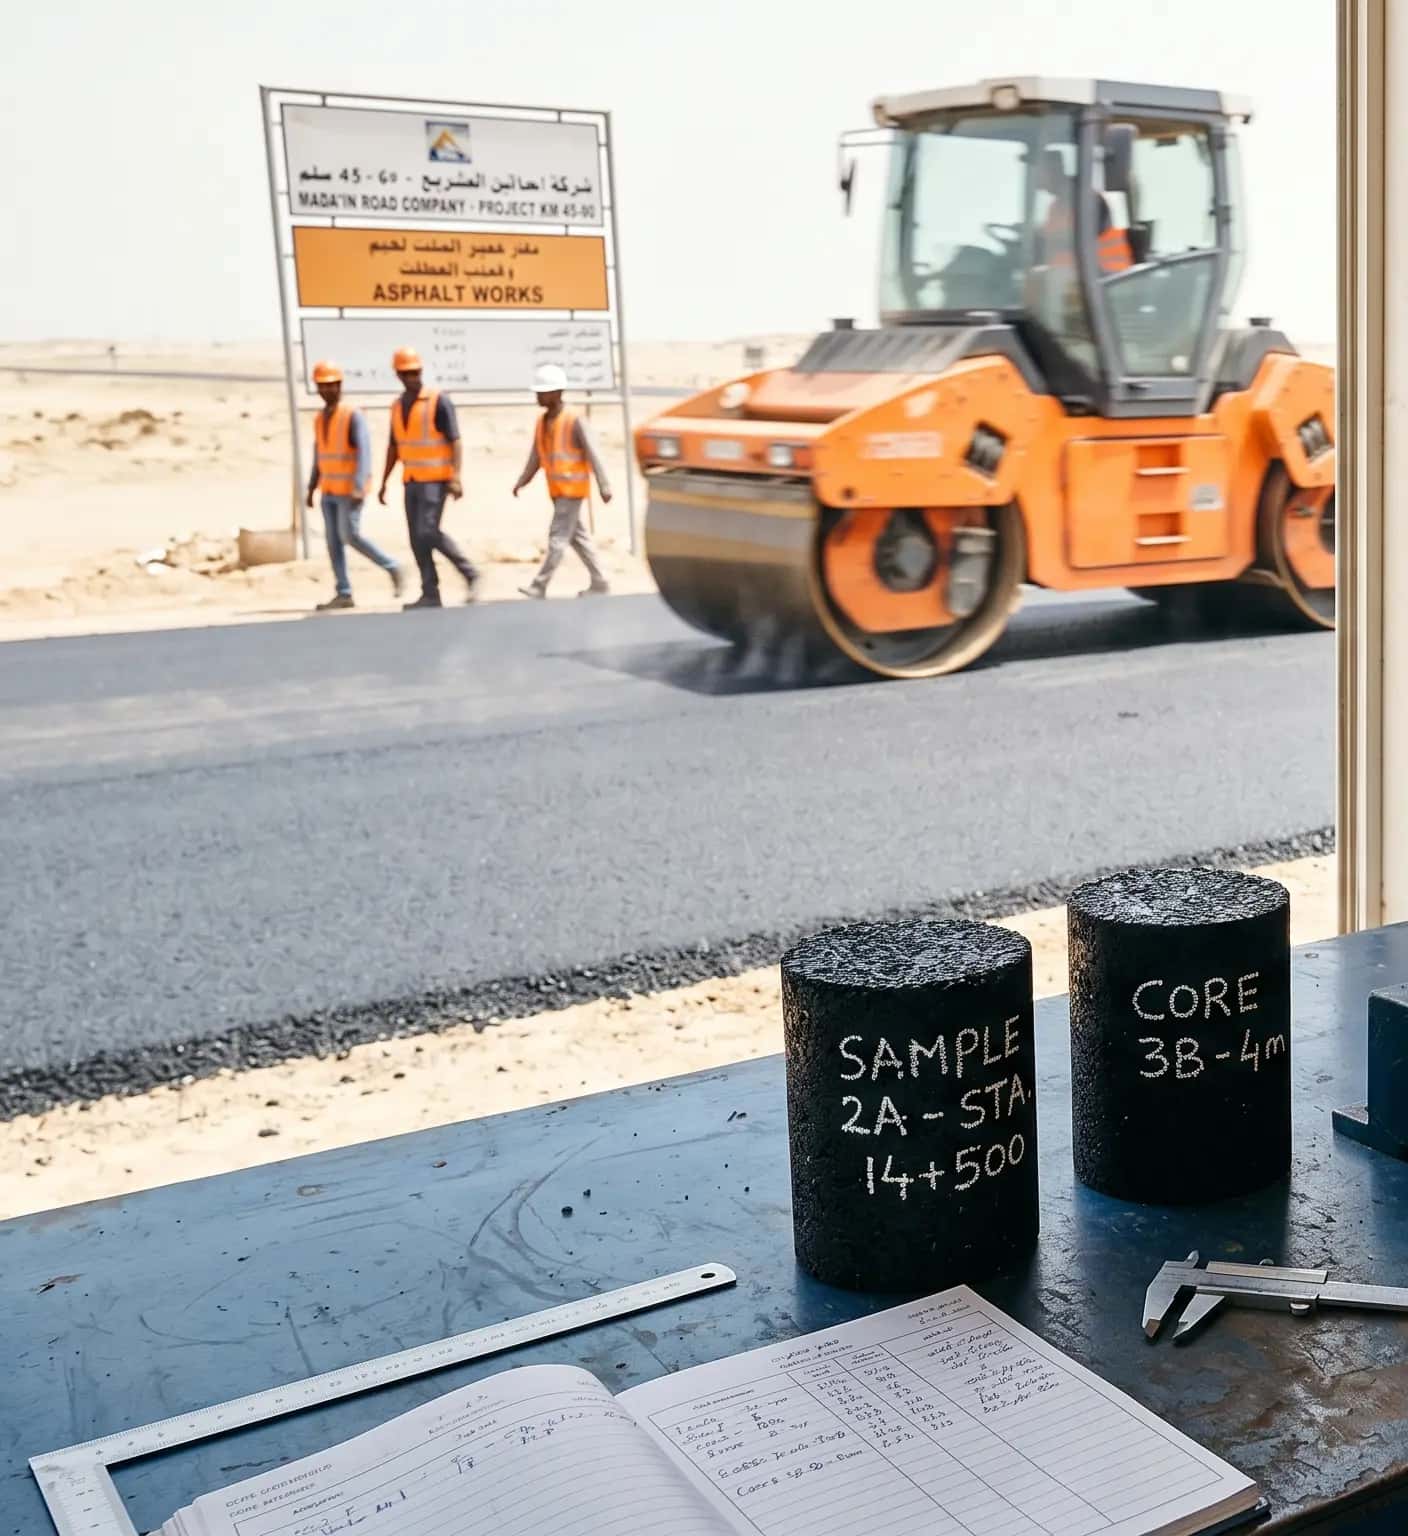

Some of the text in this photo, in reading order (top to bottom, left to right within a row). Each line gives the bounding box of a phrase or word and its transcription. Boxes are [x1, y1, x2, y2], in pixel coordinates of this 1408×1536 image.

[361, 195, 398, 211] ROAD
[402, 197, 465, 214] COMPANY
[478, 200, 535, 217] PROJECT
[540, 203, 559, 218] KM
[373, 283, 543, 304] ASPHALT WORKS
[1131, 971, 1261, 1020] CORE
[838, 1014, 1021, 1081] SAMPLE
[866, 1133, 1026, 1201] 14+500
